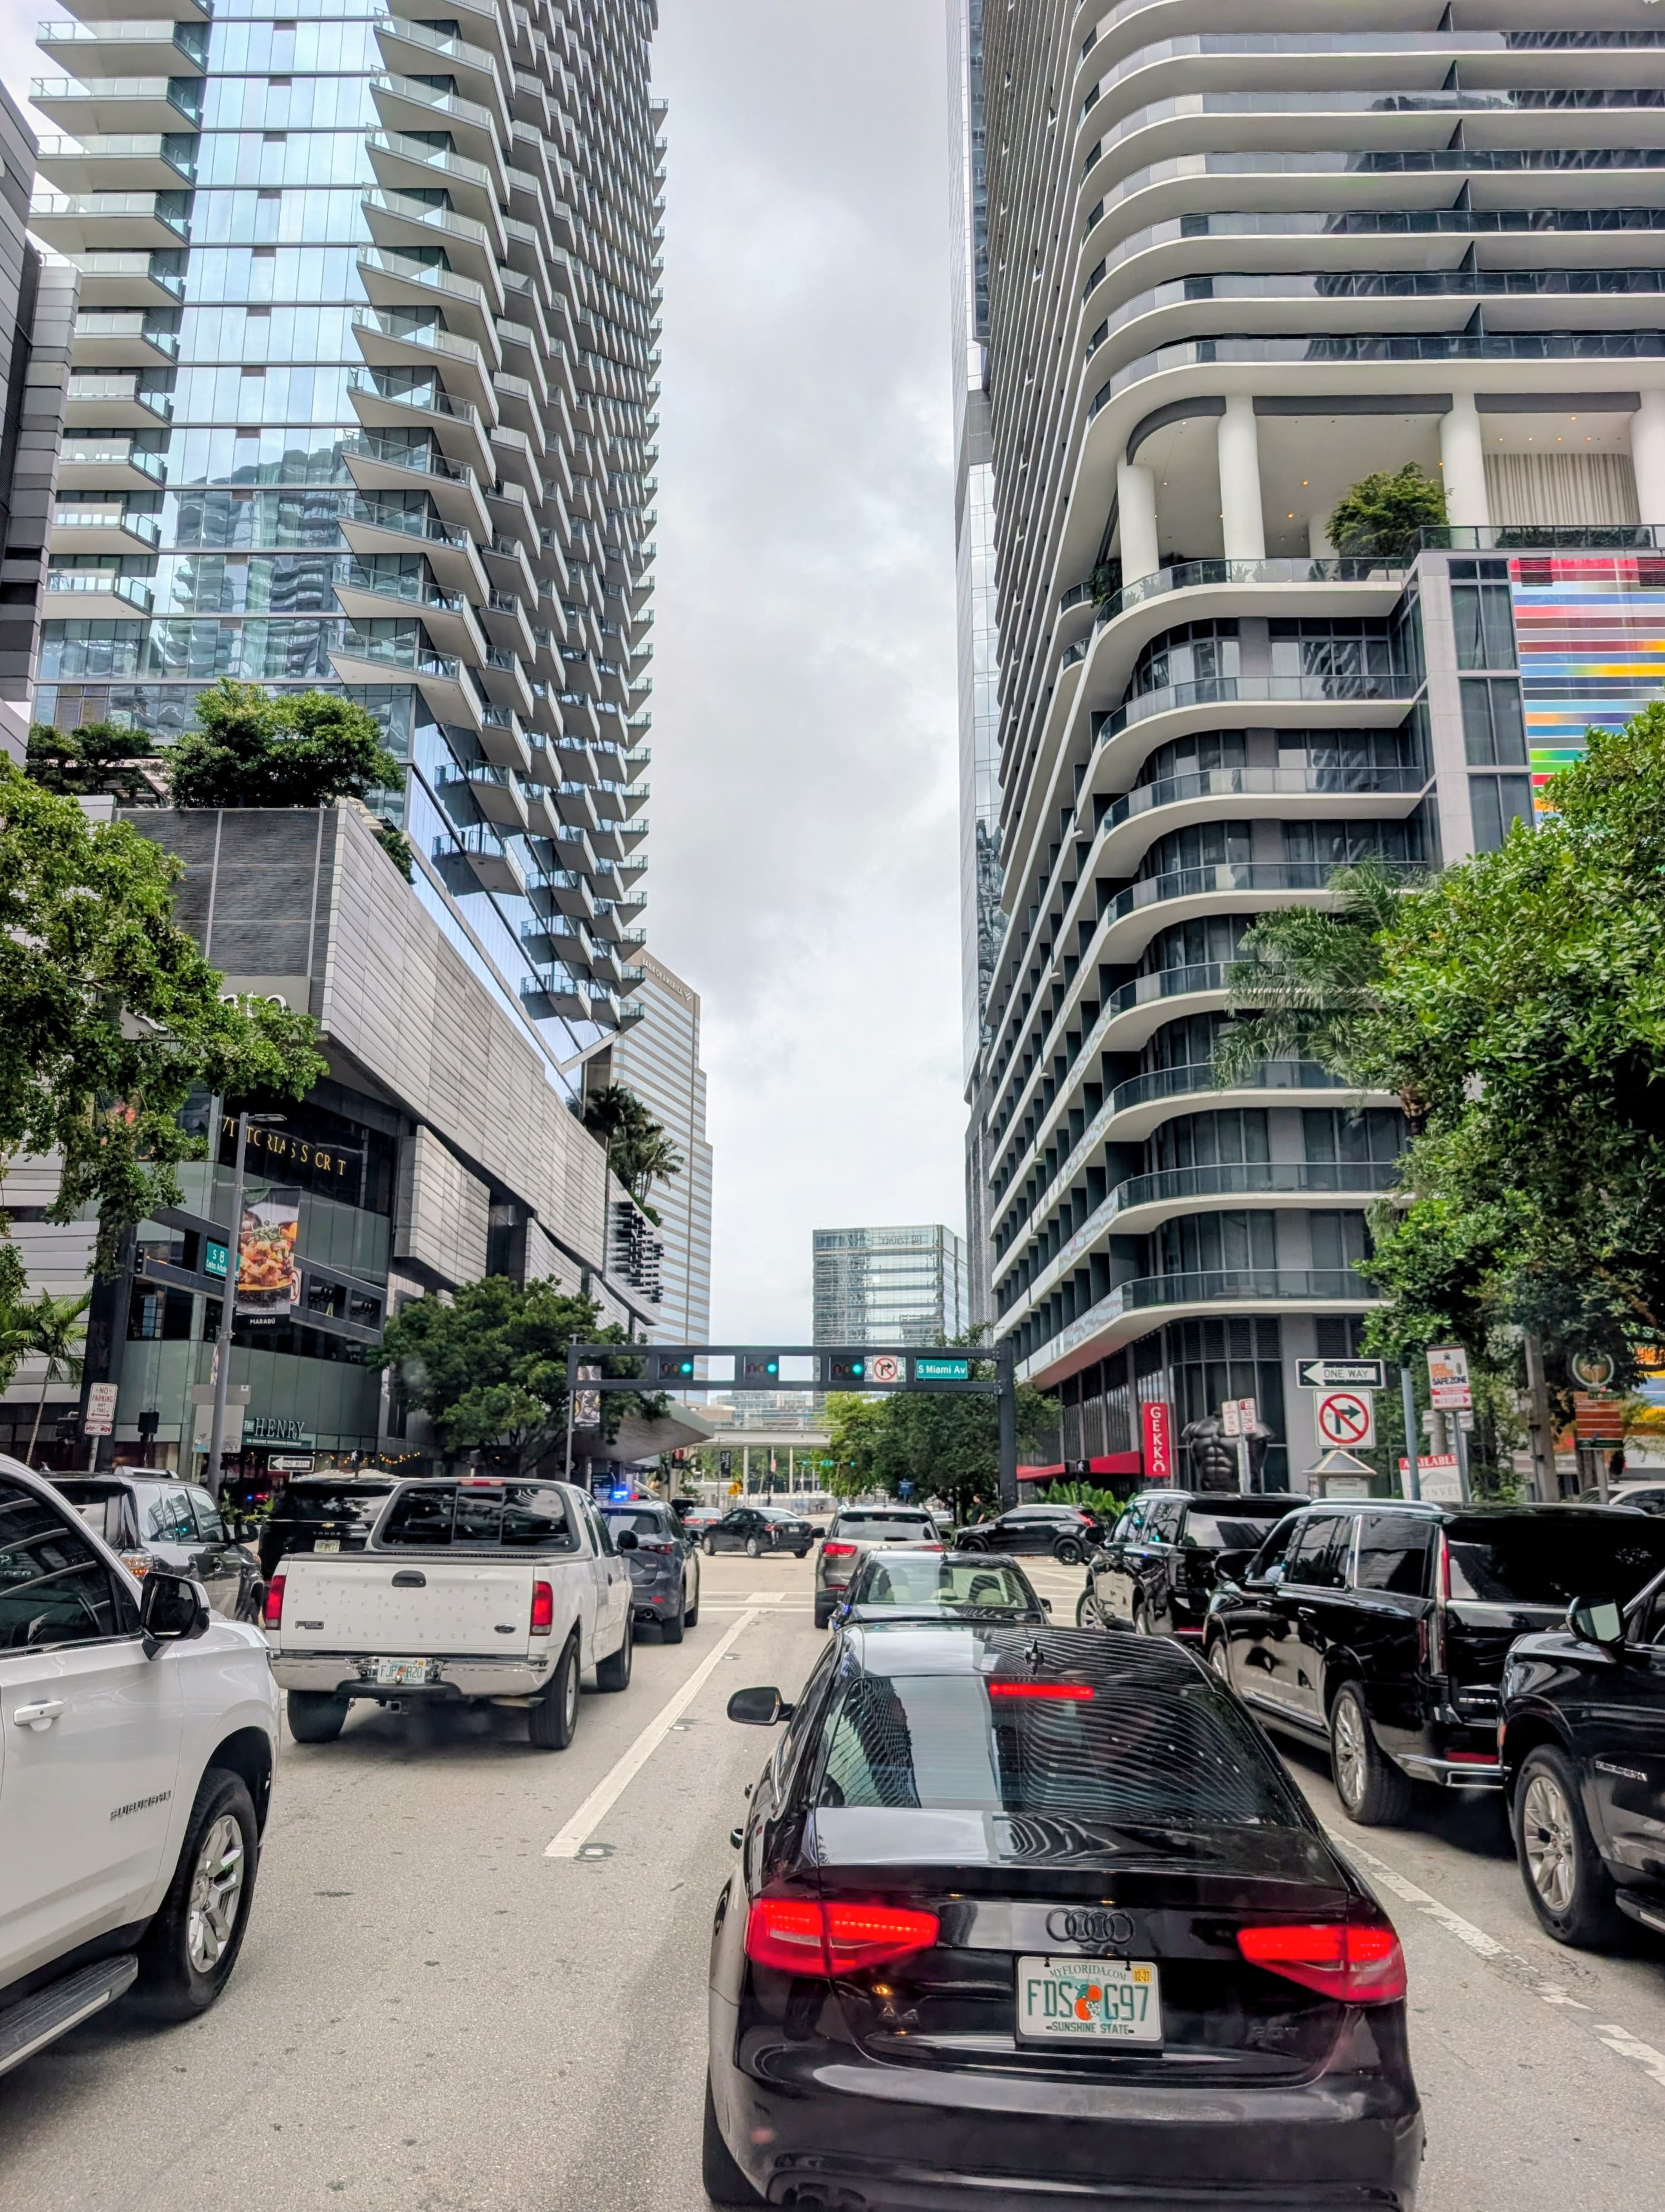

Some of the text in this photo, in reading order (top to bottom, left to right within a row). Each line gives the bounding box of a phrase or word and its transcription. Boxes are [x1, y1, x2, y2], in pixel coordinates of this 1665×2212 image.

[301, 1144, 346, 1175] SCRT
[213, 1249, 224, 1264] S 8
[918, 1365, 966, 1374] S Miami Av
[1324, 1369, 1369, 1378] ONE WAY
[1432, 1376, 1467, 1386] SAFE ZONE
[254, 1417, 305, 1440] HENRY
[1403, 1454, 1458, 1469] AILABLE
[380, 1664, 423, 1678] FJP R20
[1049, 1964, 1127, 1981] MYFLORIDA.COM
[1028, 1979, 1149, 2021] FDS G97
[1052, 2021, 1129, 2034] SUNSHINE STATE
